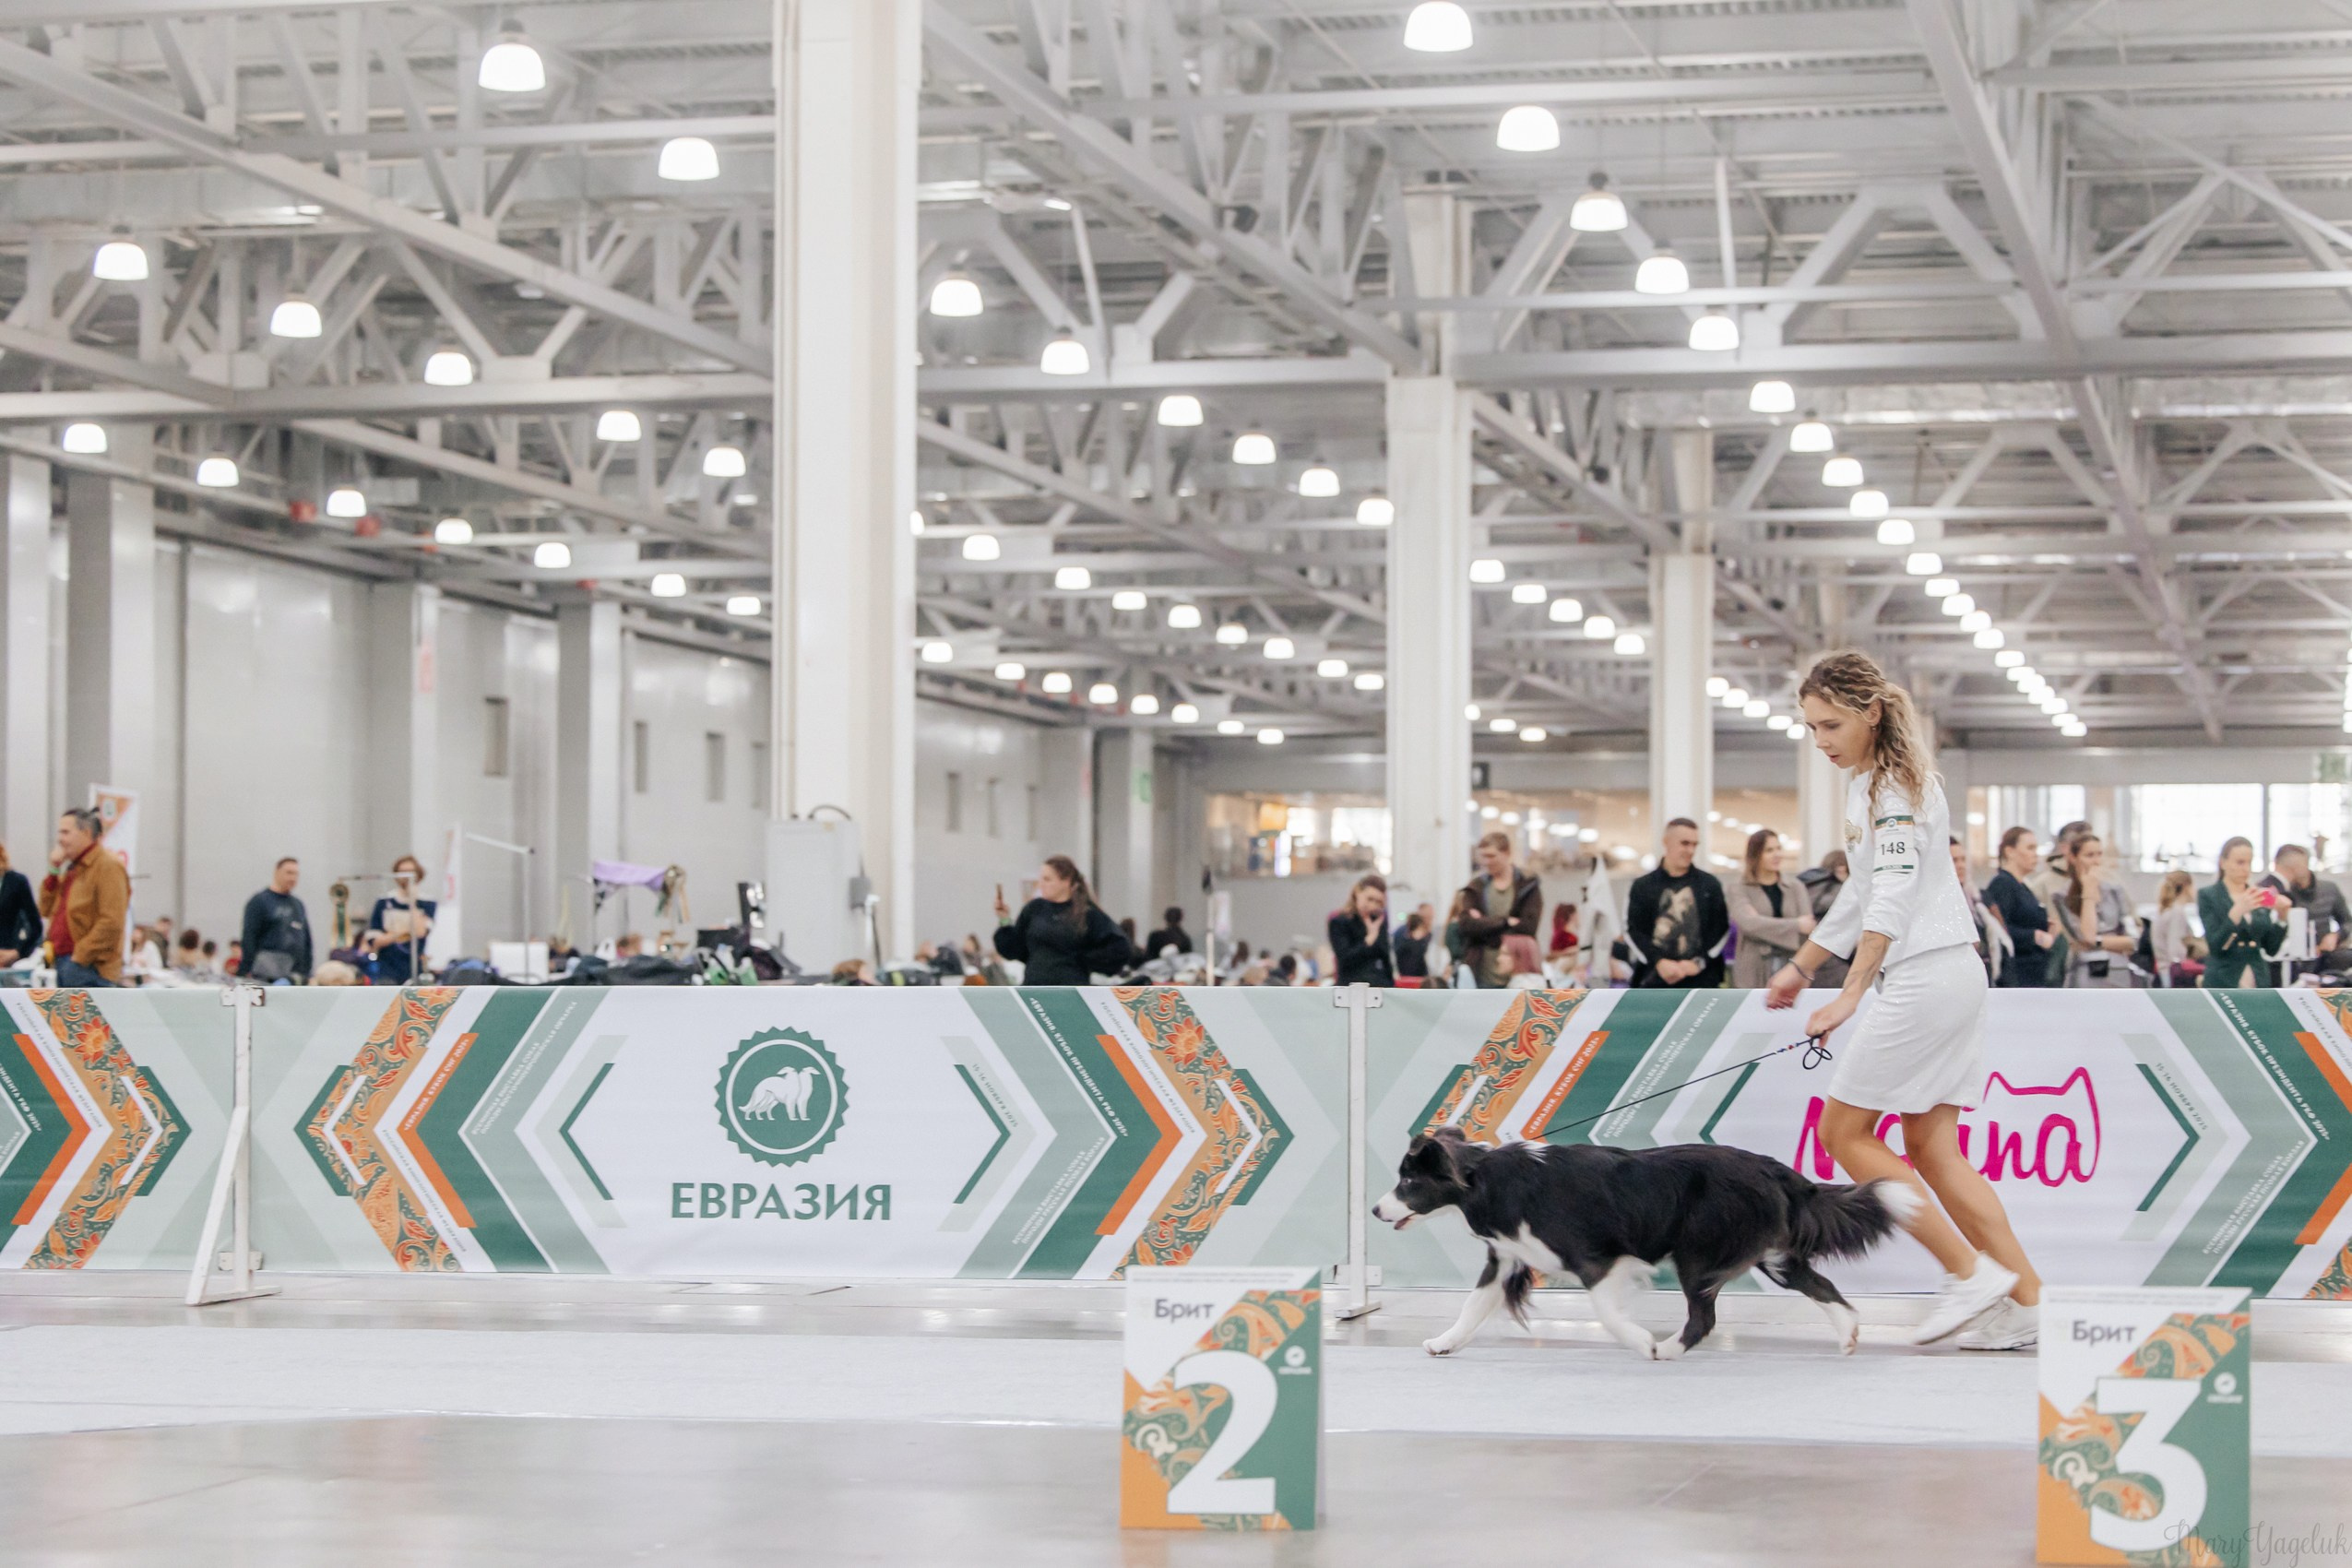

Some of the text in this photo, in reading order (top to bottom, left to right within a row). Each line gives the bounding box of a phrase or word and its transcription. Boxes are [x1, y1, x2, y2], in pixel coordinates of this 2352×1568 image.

[1881, 841, 1906, 856] 148
[426, 1072, 446, 1095] КУБОК
[1053, 1032, 1074, 1056] КУБОК
[1100, 1101, 1115, 1117] РКФ
[1552, 1072, 1575, 1097] КУБОК
[2246, 1029, 2269, 1055] КУБОК
[2299, 1102, 2316, 1120] РКФ
[16, 1097, 30, 1112] РКФ
[983, 1081, 1007, 1110] НОЯБРЯ
[1003, 1111, 1018, 1127] 2025
[2168, 1081, 2195, 1112] НОЯБРЯ
[2191, 1112, 2208, 1130] 2025
[671, 1182, 891, 1220] ЕВРАЗИЯ
[1155, 1299, 1215, 1324] Брит
[2073, 1321, 2136, 1346] Брит
[1167, 1349, 1277, 1515] 2
[2090, 1378, 2207, 1551] 3
